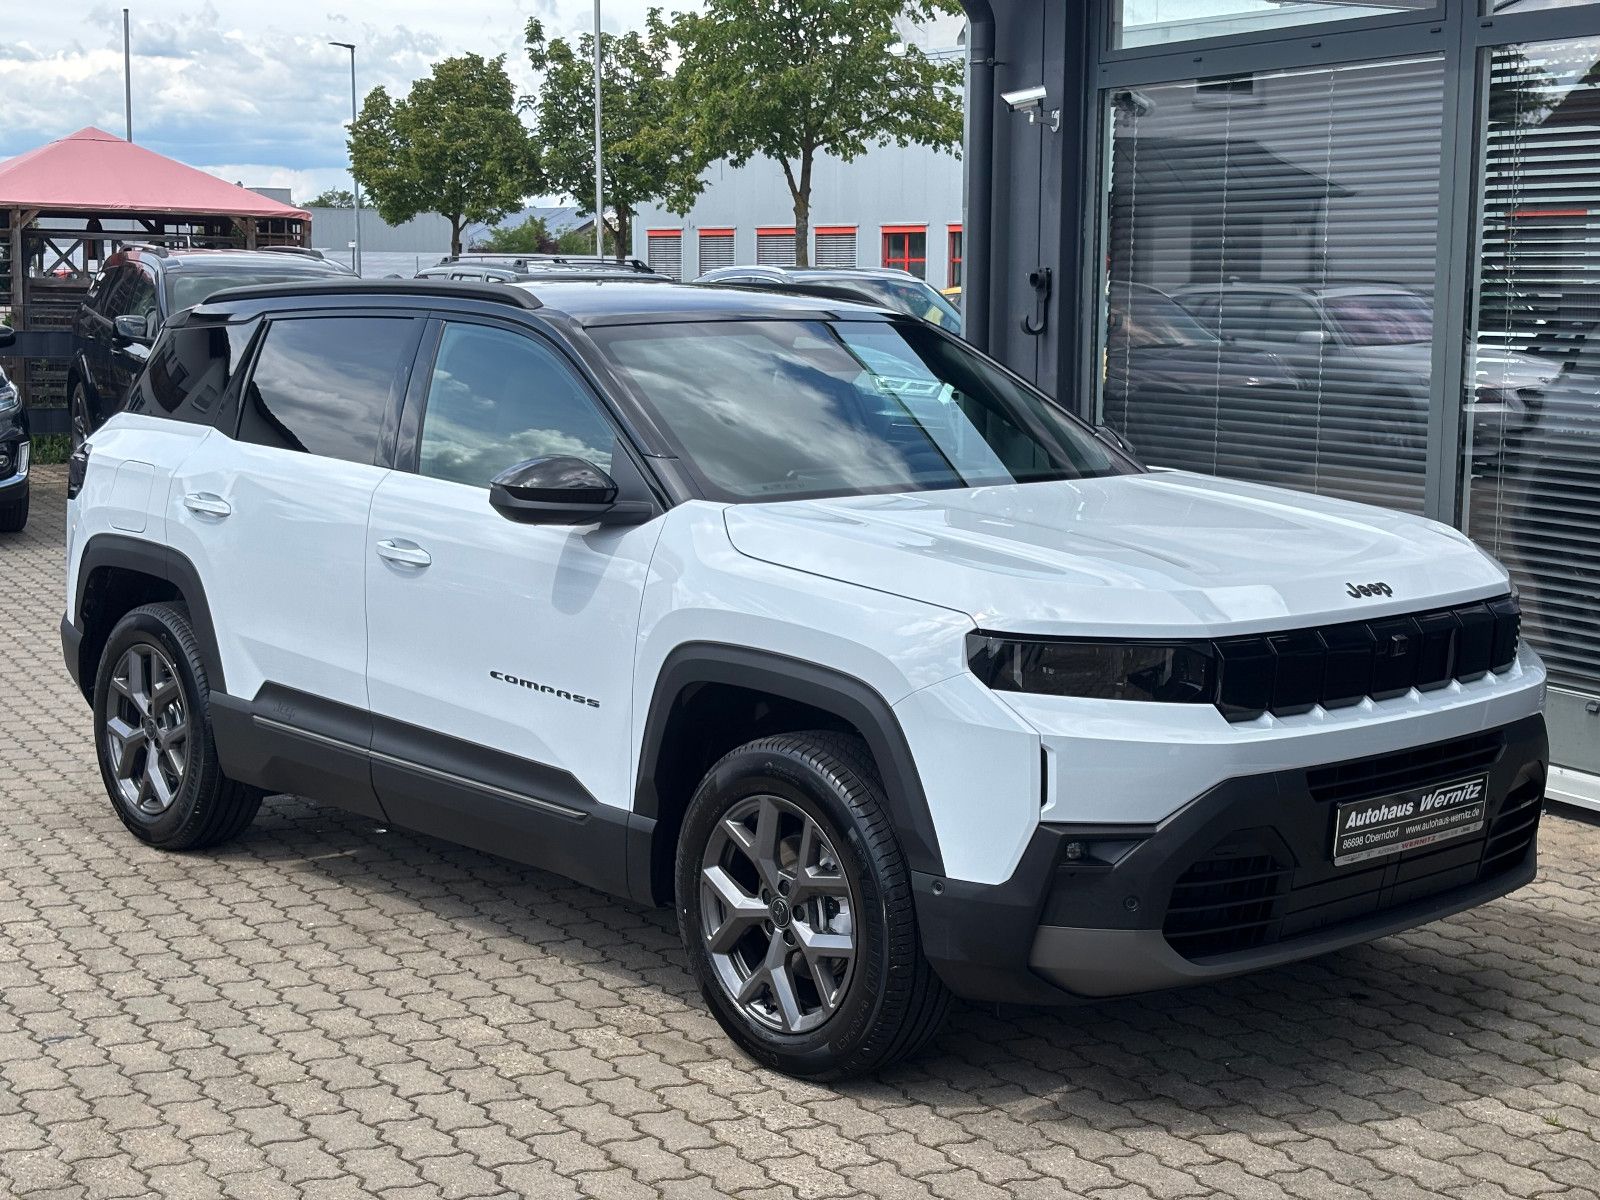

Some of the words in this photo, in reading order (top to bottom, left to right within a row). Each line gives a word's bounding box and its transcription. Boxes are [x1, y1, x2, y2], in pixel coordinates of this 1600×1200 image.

[1345, 582, 1393, 599] Jeep
[489, 670, 600, 708] COMPASS
[1345, 801, 1414, 829] Autohaus
[1420, 781, 1483, 812] Wernitz
[1405, 808, 1480, 834] www.autohaus-wernitz.de
[1342, 836, 1364, 850] 86698
[1365, 827, 1400, 844] Oberndorf
[1402, 835, 1437, 849] WERNITZ
